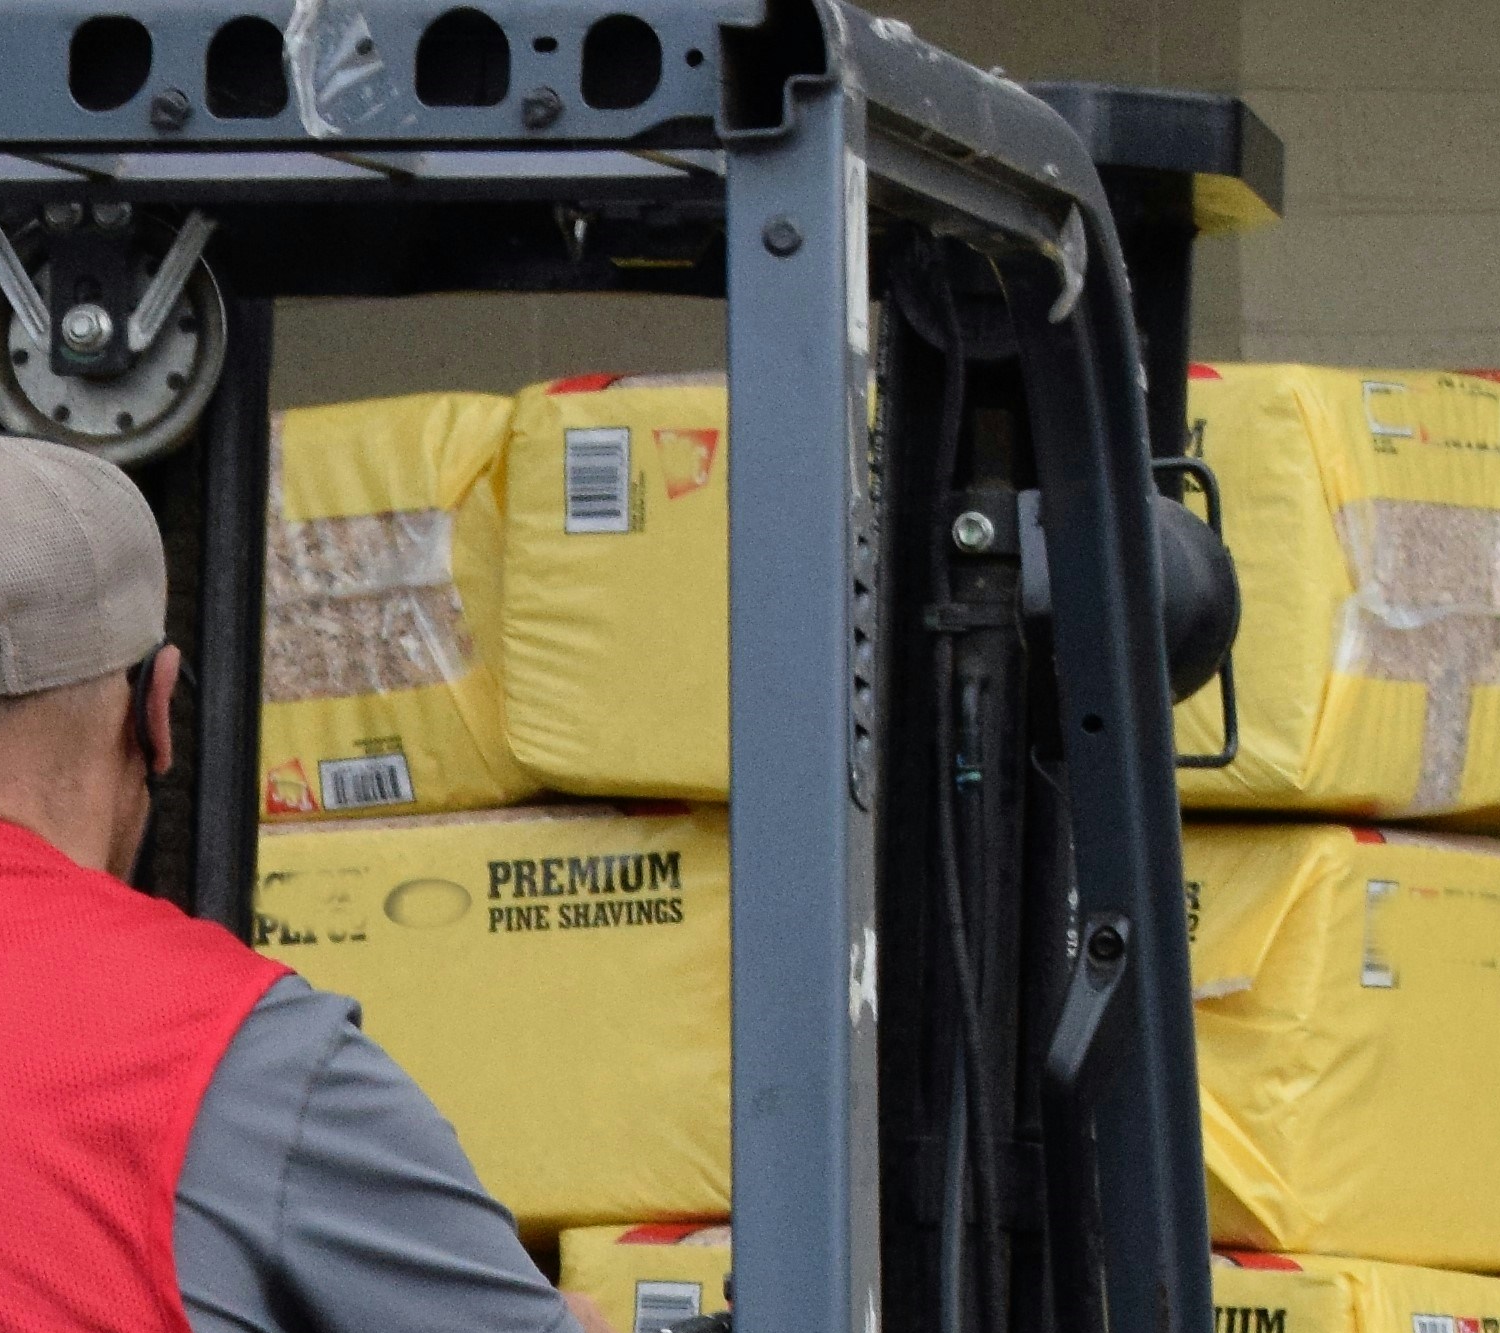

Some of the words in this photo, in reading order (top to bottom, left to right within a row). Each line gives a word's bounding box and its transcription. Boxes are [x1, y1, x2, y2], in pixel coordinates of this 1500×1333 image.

[487, 851, 682, 899] PREMIUM
[488, 905, 551, 933] PINE
[558, 897, 684, 931] SHAVINGS
